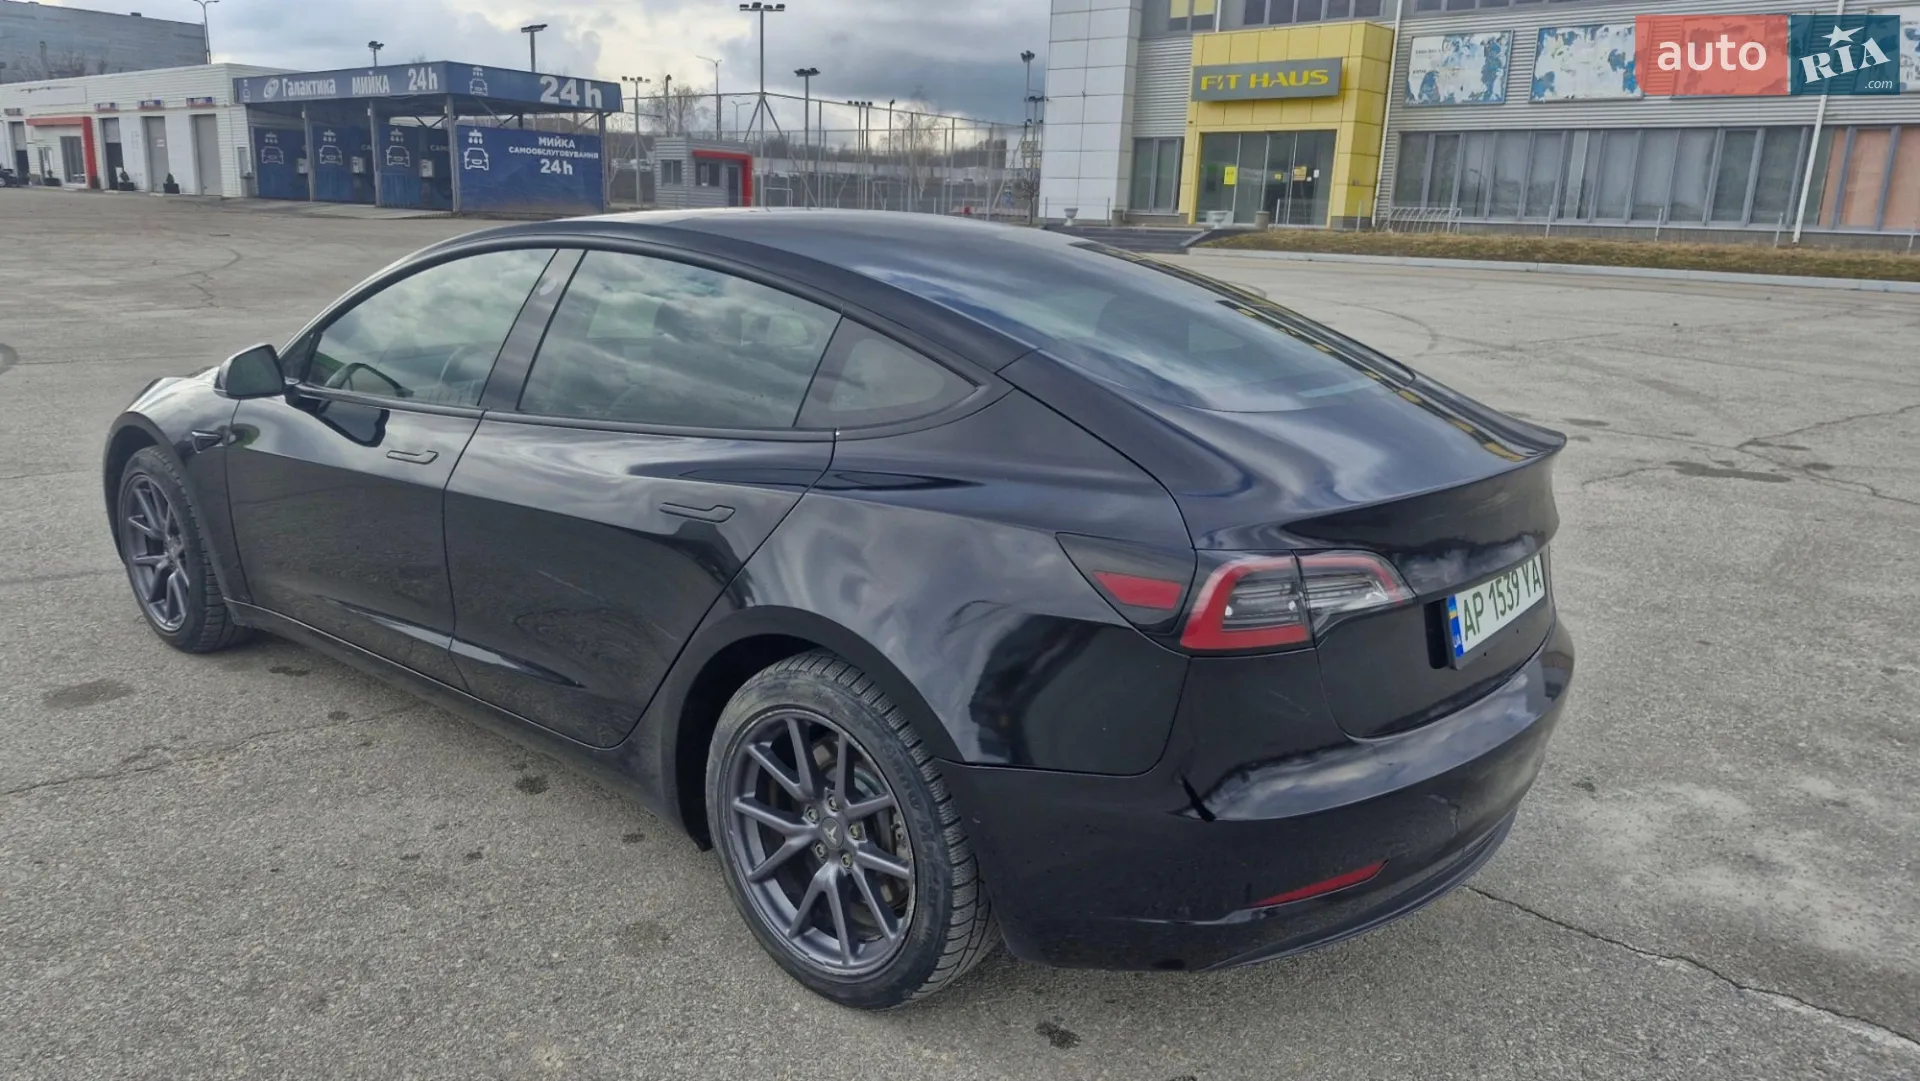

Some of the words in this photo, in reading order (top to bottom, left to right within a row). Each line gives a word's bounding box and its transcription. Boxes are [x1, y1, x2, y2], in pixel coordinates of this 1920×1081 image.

[282, 78, 336, 97] Галактика
[352, 70, 390, 95] МИЙКА
[408, 67, 438, 92] 24h
[1200, 74, 1242, 91] FIT
[1249, 69, 1329, 89] HAUS
[540, 75, 603, 109] 24h
[508, 146, 599, 159] САМООБСЛУГОВУВАННЯ
[538, 135, 575, 149] МИЙКА
[540, 158, 573, 175] 24h
[1463, 591, 1484, 642] AP
[1489, 570, 1520, 621] 1539
[1520, 558, 1542, 598] YA
